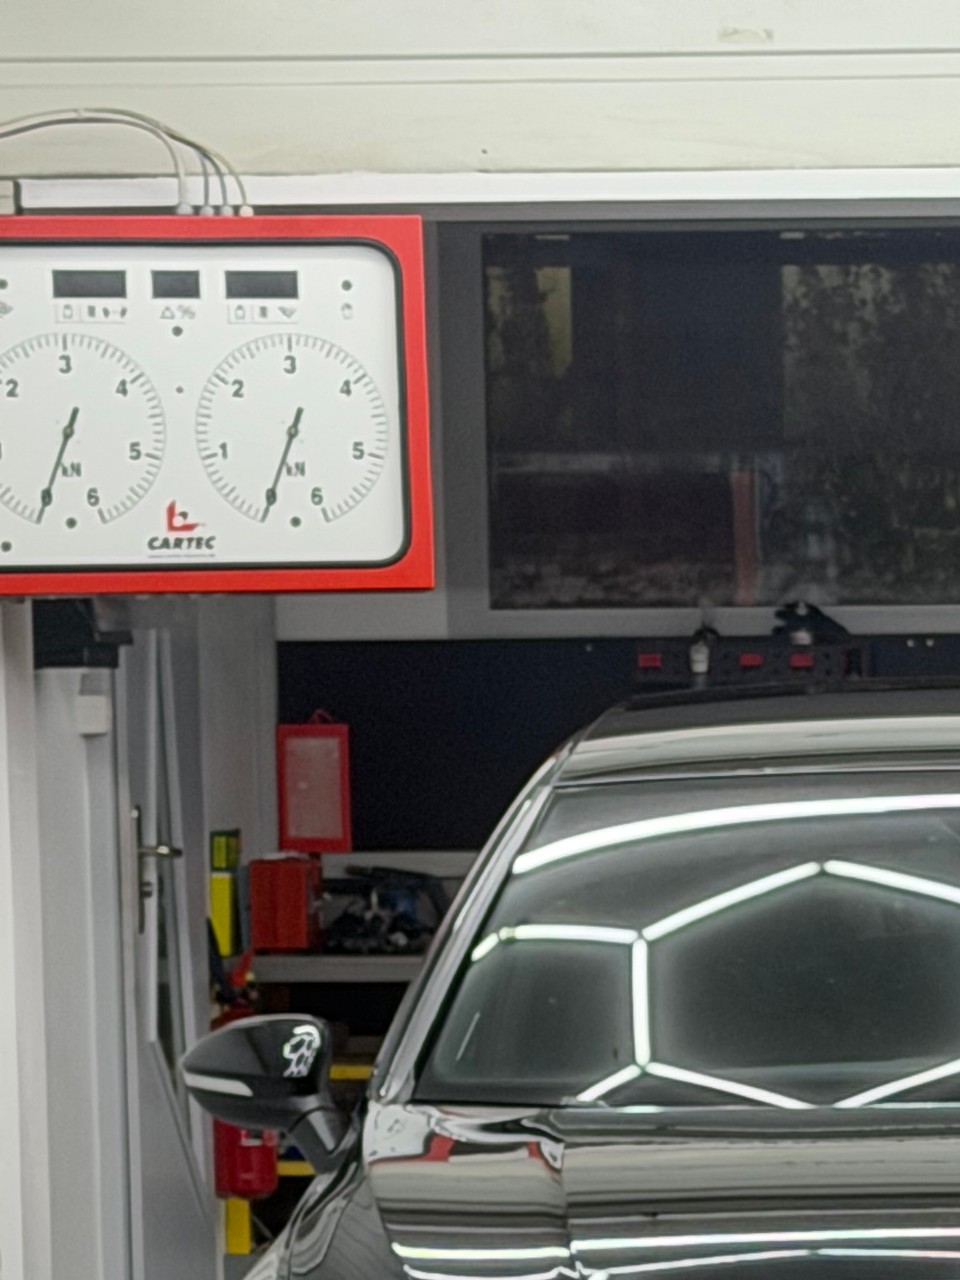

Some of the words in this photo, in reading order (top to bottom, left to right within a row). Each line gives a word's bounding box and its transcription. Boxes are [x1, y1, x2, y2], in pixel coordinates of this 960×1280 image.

[58, 354, 72, 374] 3
[283, 355, 297, 374] 3
[6, 378, 19, 398] 2
[115, 378, 128, 397] 4
[231, 379, 244, 398] 2
[339, 379, 352, 397] 4
[129, 441, 142, 460] 5
[219, 441, 228, 460] 1
[352, 441, 365, 460] 5
[87, 487, 100, 507] 6
[311, 486, 324, 506] 6
[147, 535, 217, 551] CARTEC
